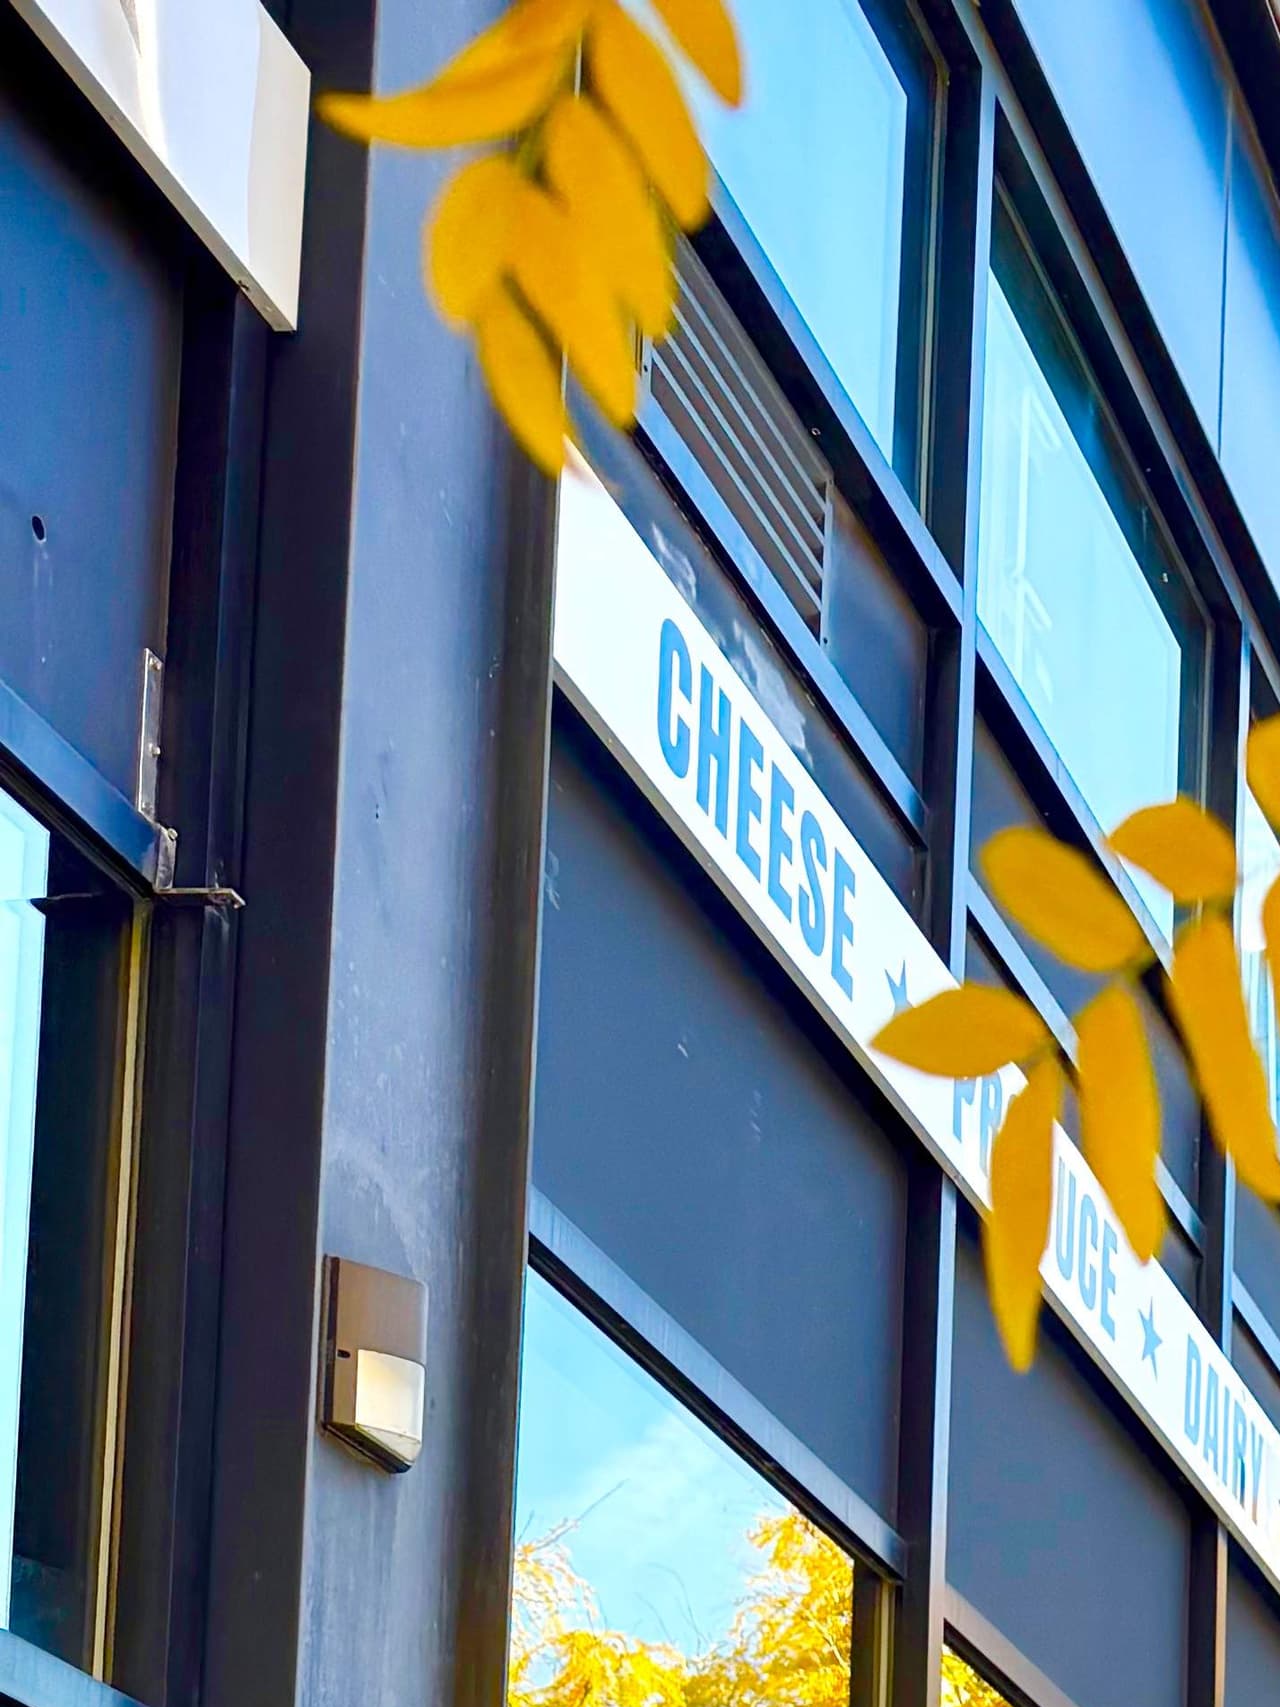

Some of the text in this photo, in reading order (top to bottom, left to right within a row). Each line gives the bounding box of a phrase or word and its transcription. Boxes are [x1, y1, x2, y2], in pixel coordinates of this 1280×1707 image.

[659, 618, 855, 1002] CHEESE
[953, 1062, 1118, 1341] PRUCE
[1184, 1333, 1263, 1525] DAIRY
